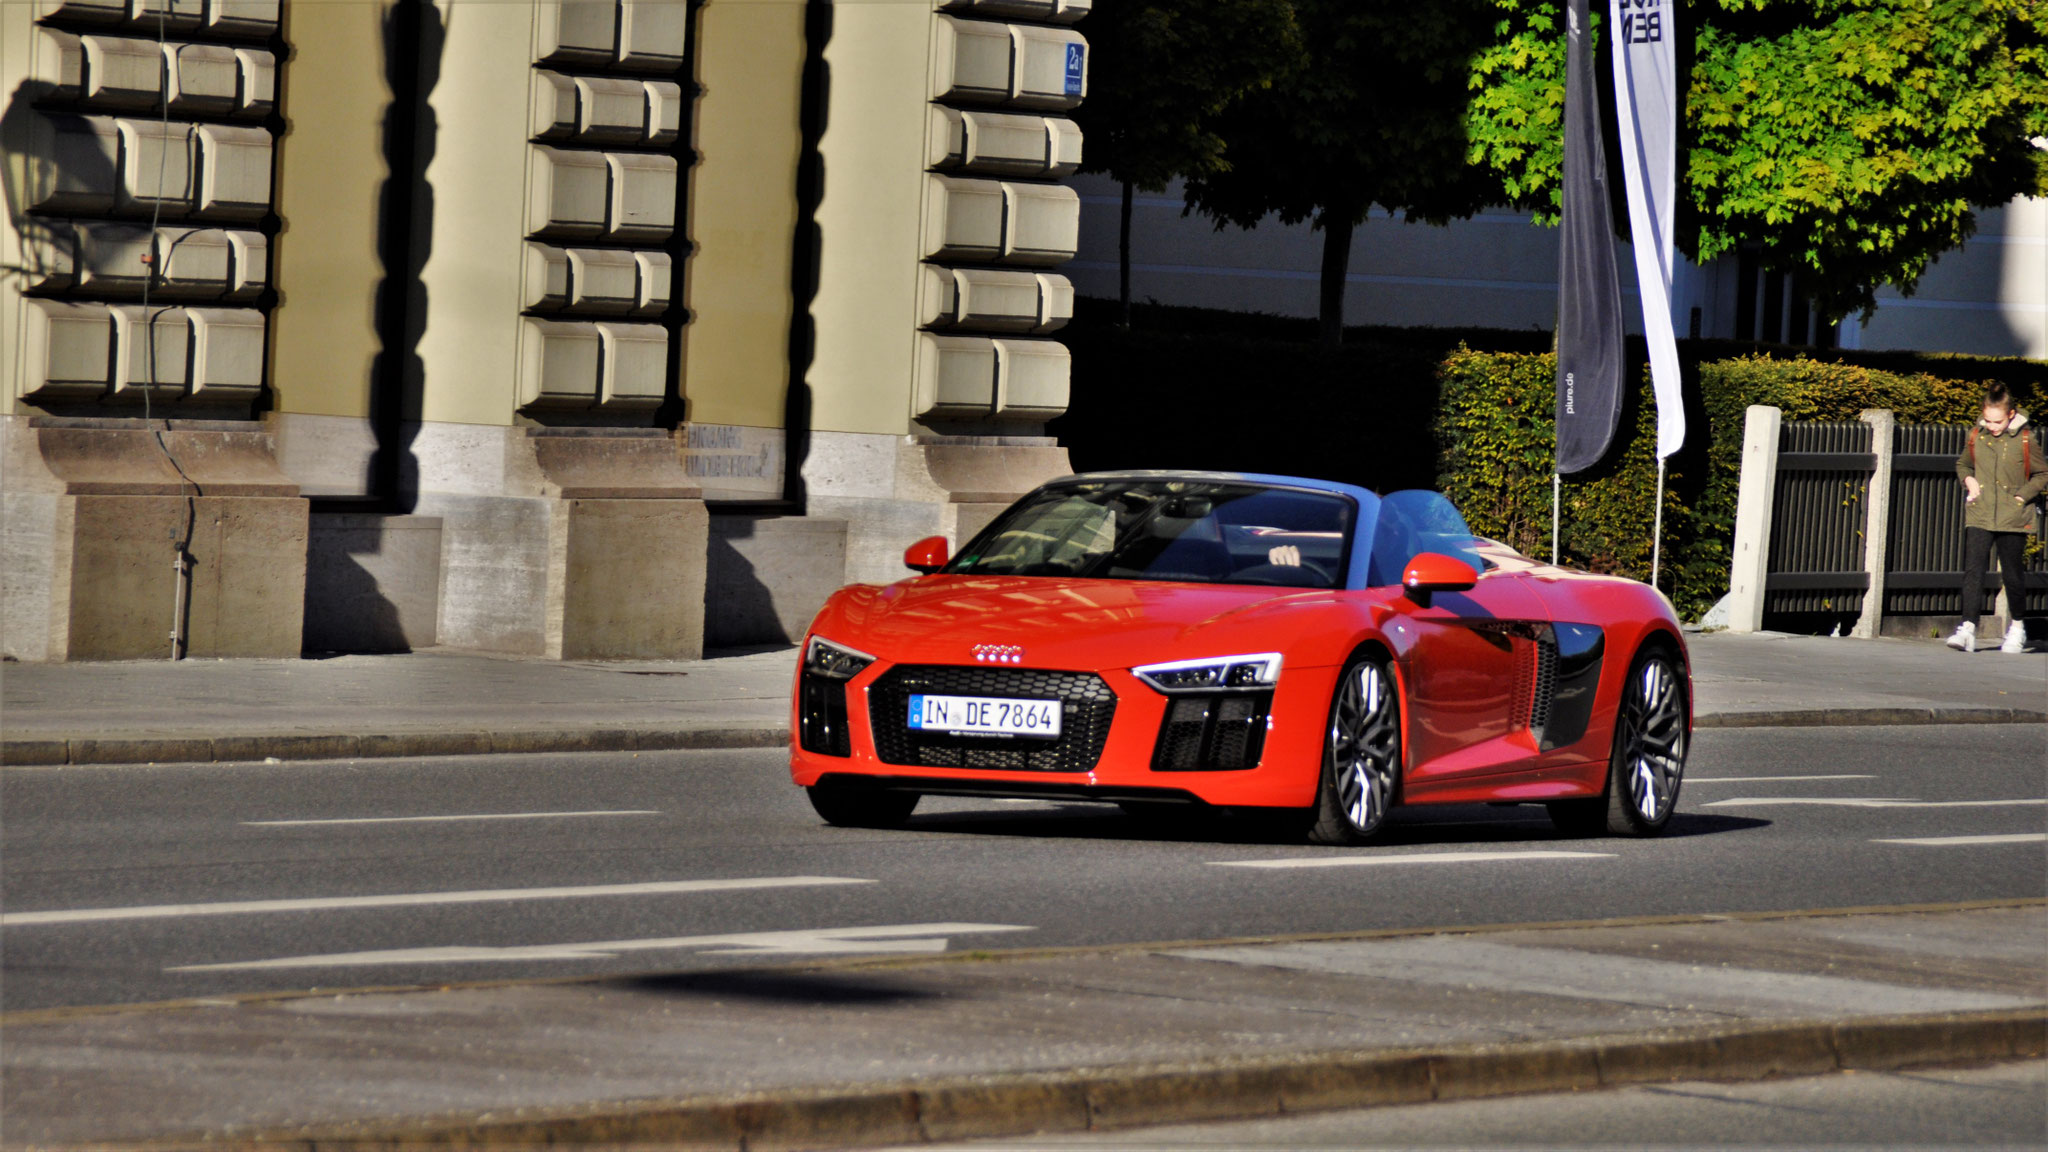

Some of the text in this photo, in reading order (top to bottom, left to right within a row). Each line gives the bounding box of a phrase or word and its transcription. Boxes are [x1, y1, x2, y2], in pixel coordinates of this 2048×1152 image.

[1565, 372, 1575, 415] piure.de
[925, 700, 1052, 729] IN DE 7864
